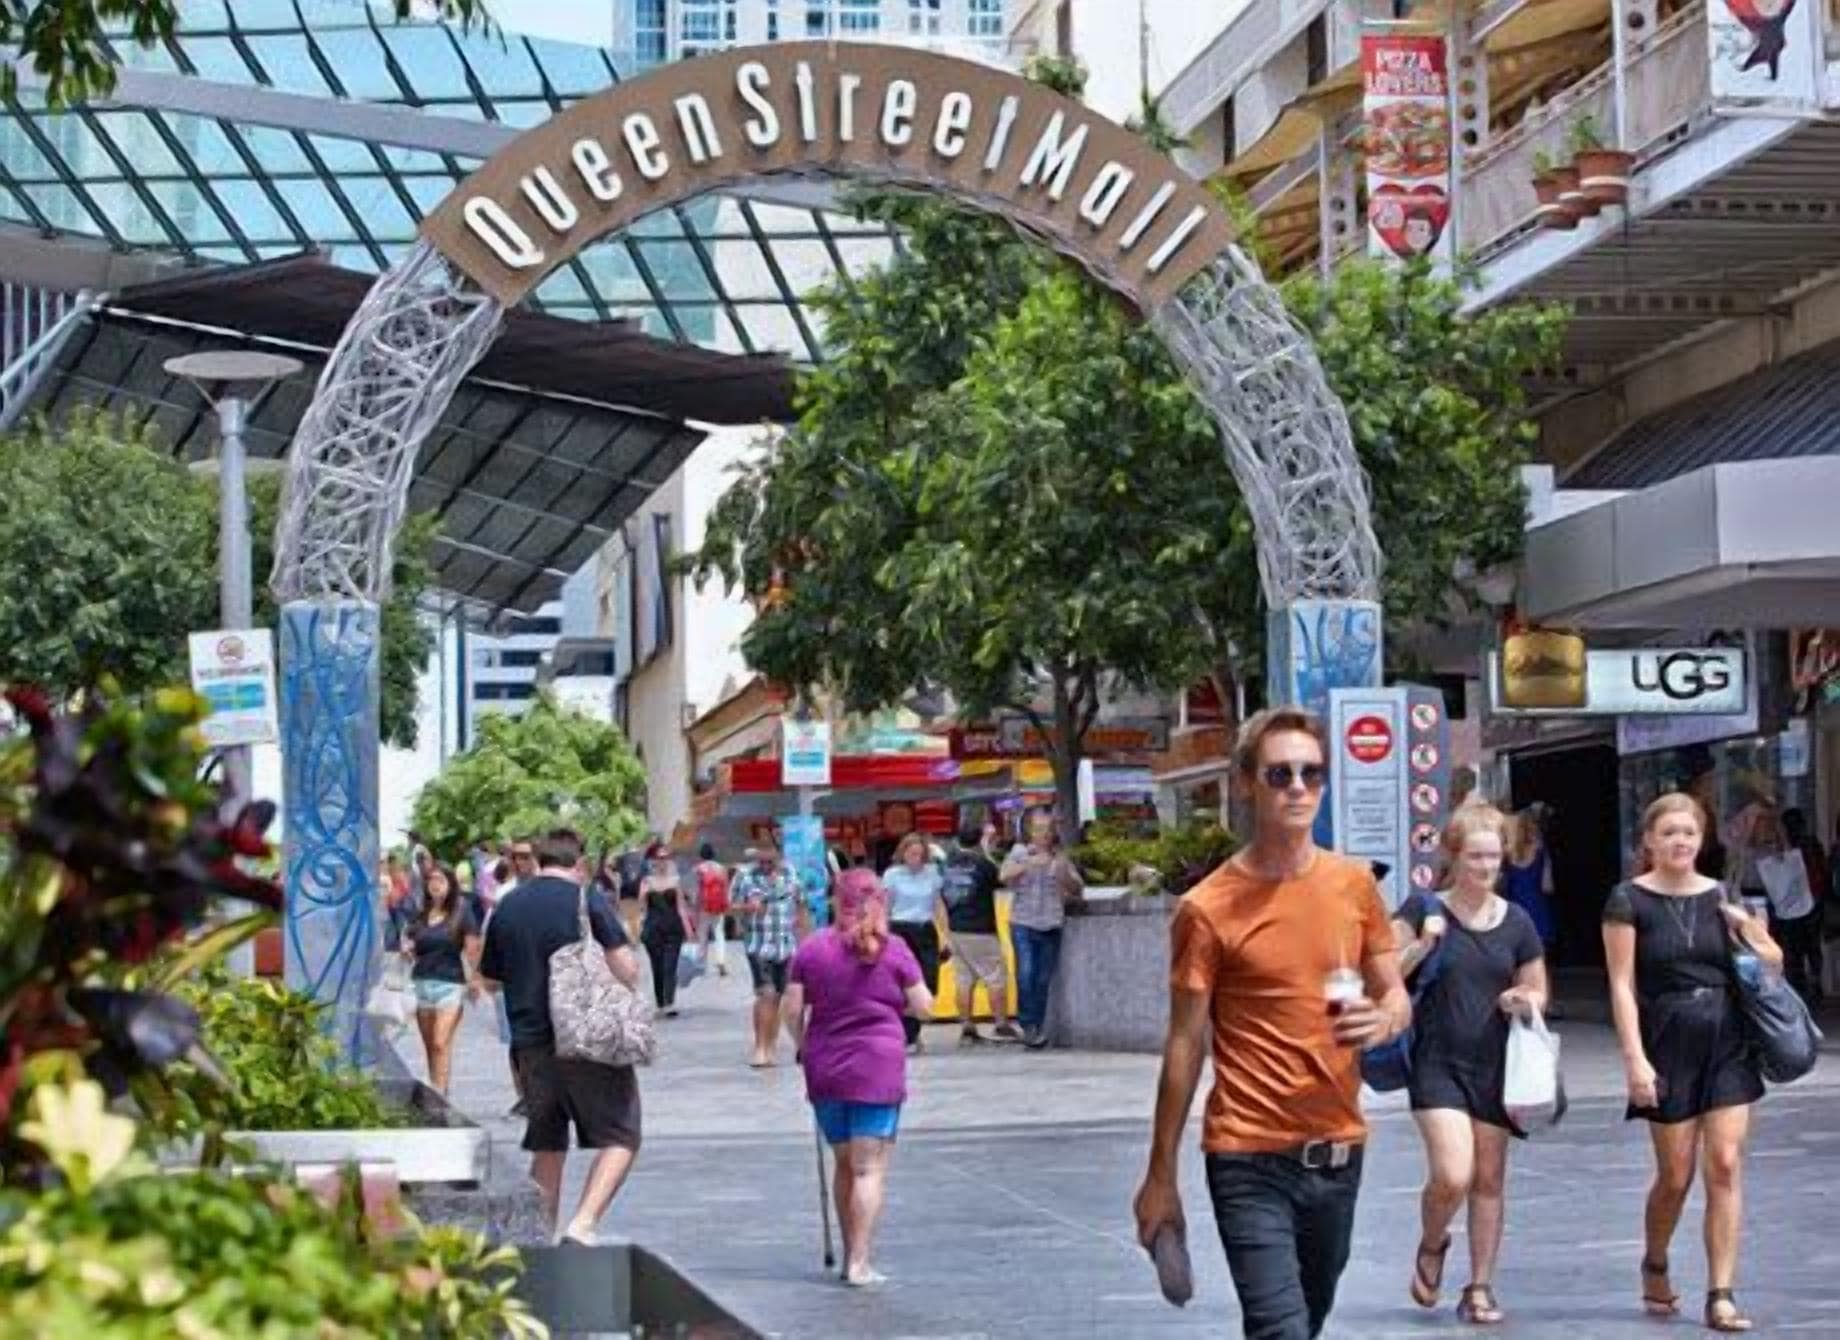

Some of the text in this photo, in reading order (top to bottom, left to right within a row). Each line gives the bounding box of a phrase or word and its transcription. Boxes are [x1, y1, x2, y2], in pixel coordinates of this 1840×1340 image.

[463, 61, 1208, 272] Queen Street Mall
[1631, 651, 1729, 700] UGG
